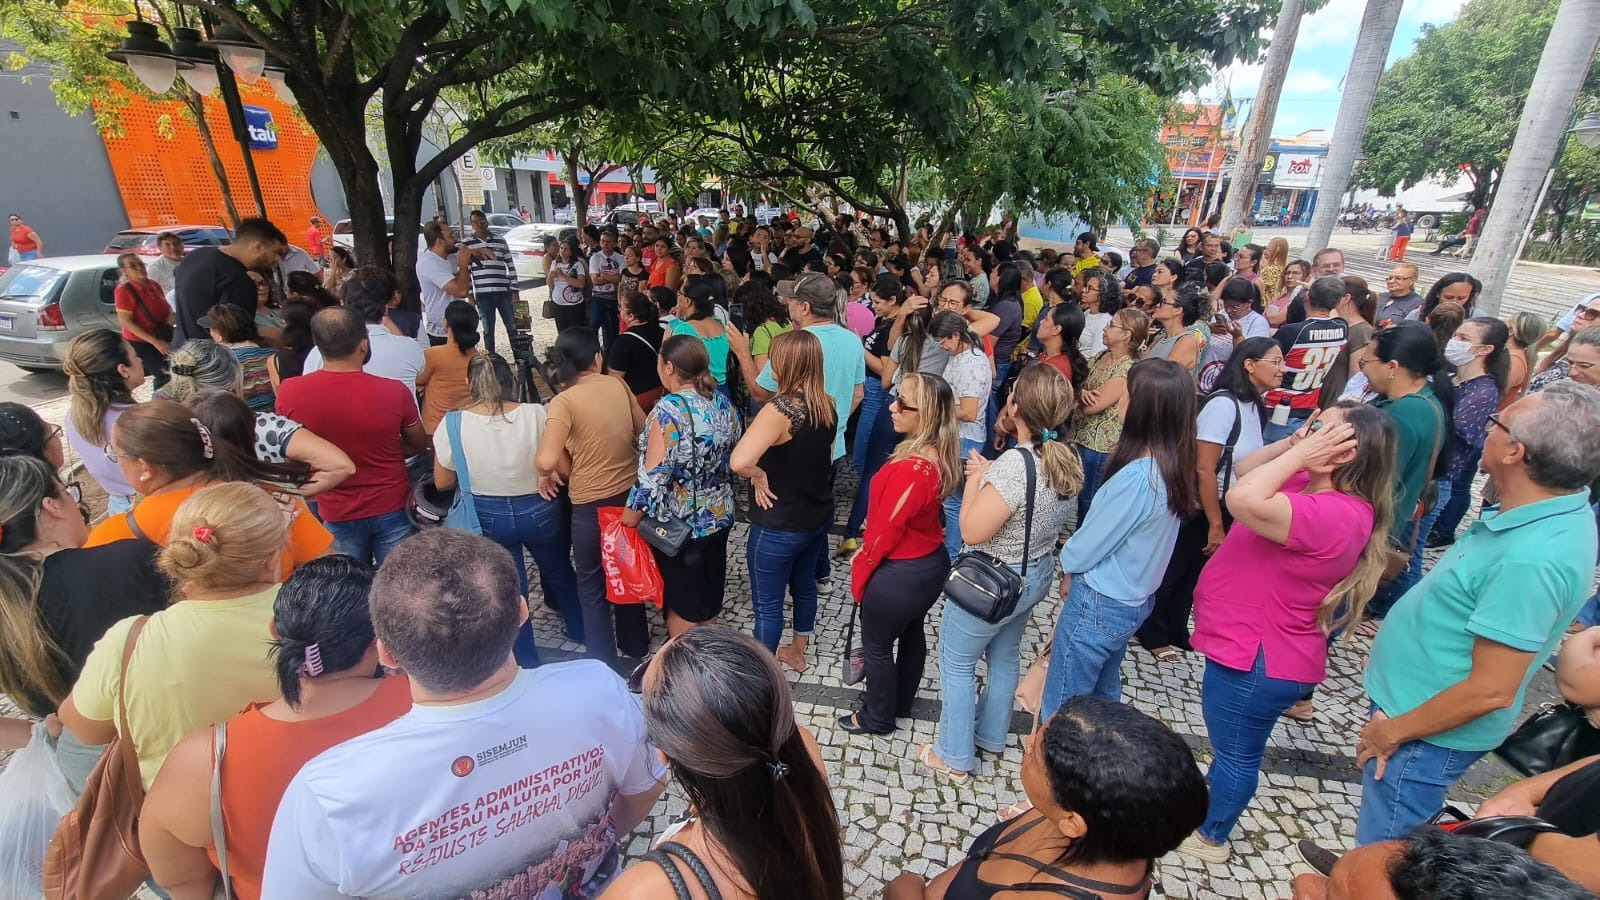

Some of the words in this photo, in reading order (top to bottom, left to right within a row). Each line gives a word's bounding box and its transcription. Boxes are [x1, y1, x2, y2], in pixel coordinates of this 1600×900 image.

[463, 155, 473, 168] E
[1288, 161, 1311, 174] FOX
[1309, 328, 1344, 340] FREDERICO
[476, 735, 527, 761] SISEMJUN
[393, 802, 470, 850] AGENTES
[474, 744, 605, 810] ADMINISTRATIVOS
[402, 838, 426, 854] DA
[428, 811, 483, 844] SESAU
[487, 800, 510, 819] NA
[513, 783, 551, 808] LUTA
[553, 768, 581, 790] POR
[584, 757, 602, 775] UM
[398, 825, 488, 876] REAJUSTE
[494, 792, 562, 838] SALARIAL
